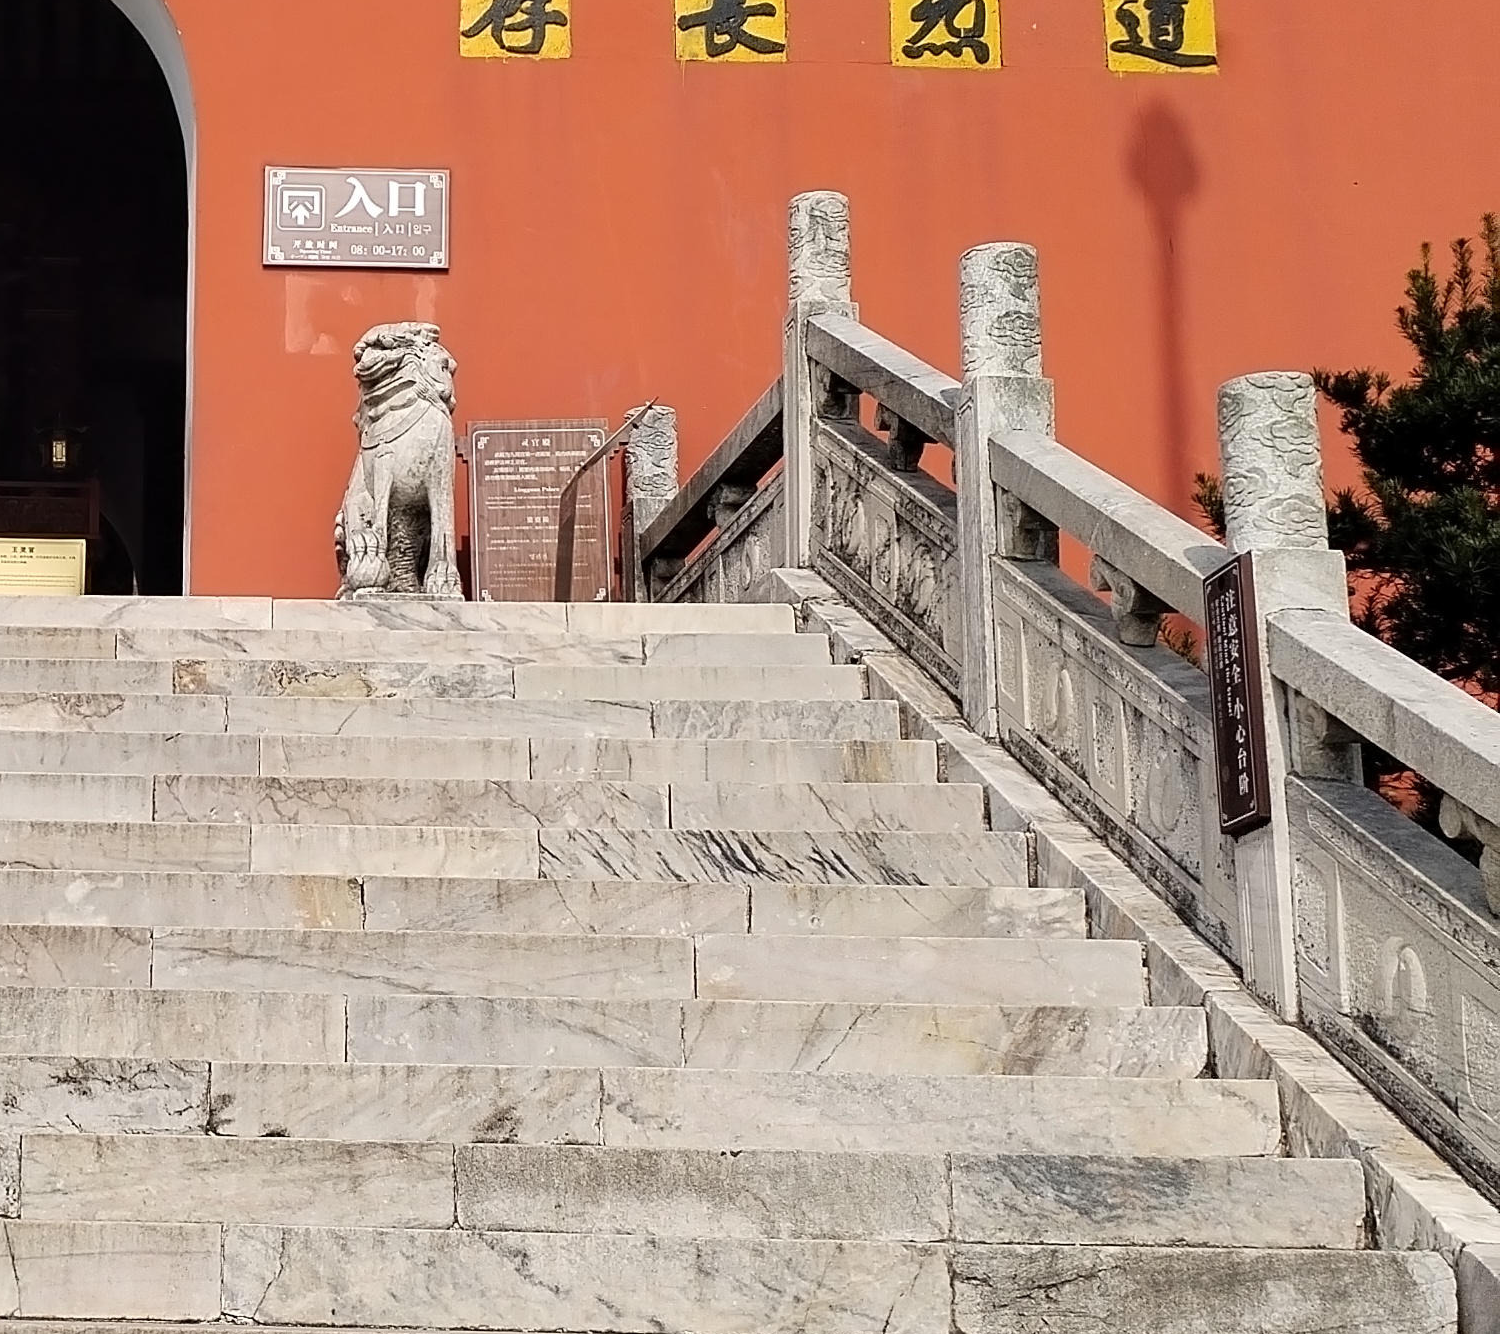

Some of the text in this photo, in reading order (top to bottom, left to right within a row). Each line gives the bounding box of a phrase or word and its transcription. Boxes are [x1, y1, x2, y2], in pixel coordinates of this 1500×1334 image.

[334, 176, 427, 219] 入口
[330, 223, 373, 234] Entrance
[1224, 589, 1250, 795] 注意安全 小心台阶
